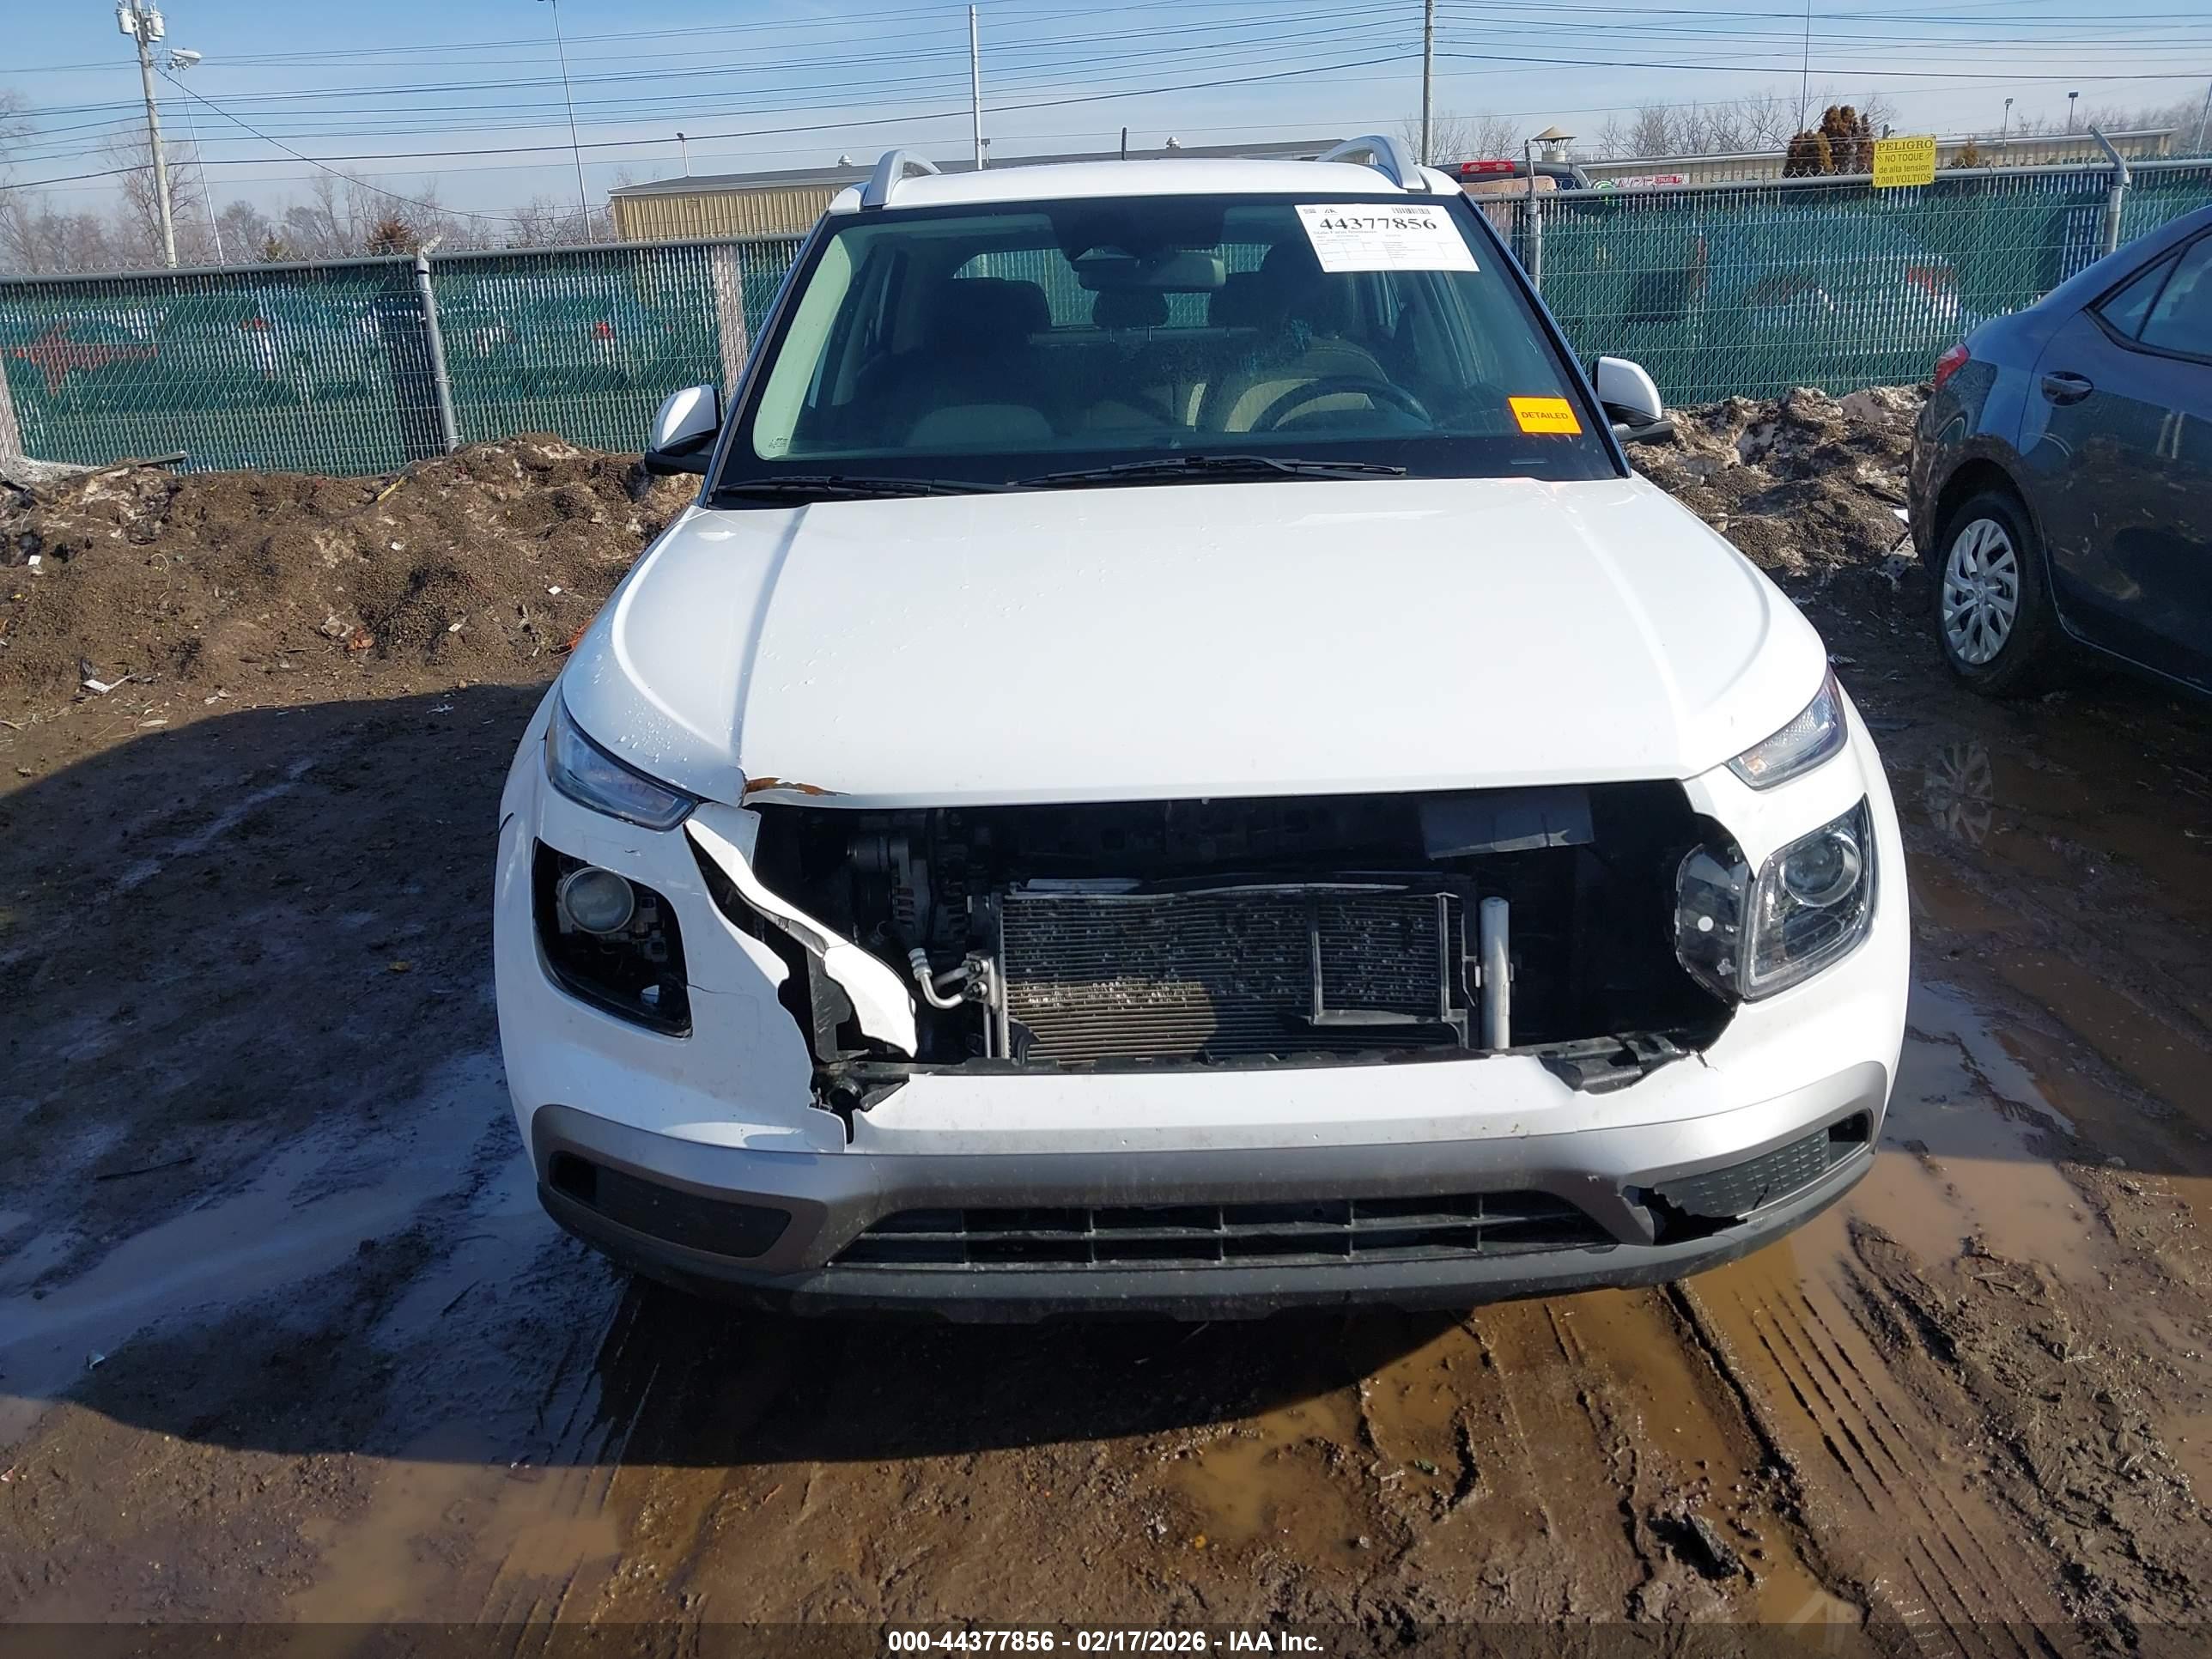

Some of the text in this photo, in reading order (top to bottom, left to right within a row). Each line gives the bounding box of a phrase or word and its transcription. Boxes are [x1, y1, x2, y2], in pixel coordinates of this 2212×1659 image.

[1877, 140, 1933, 151] PELIGRO
[1898, 153, 1923, 161] TOQUE
[1904, 164, 1929, 173] tension
[1875, 173, 1931, 185] 7,000 VOLTIOS
[1320, 217, 1437, 230] 44377856
